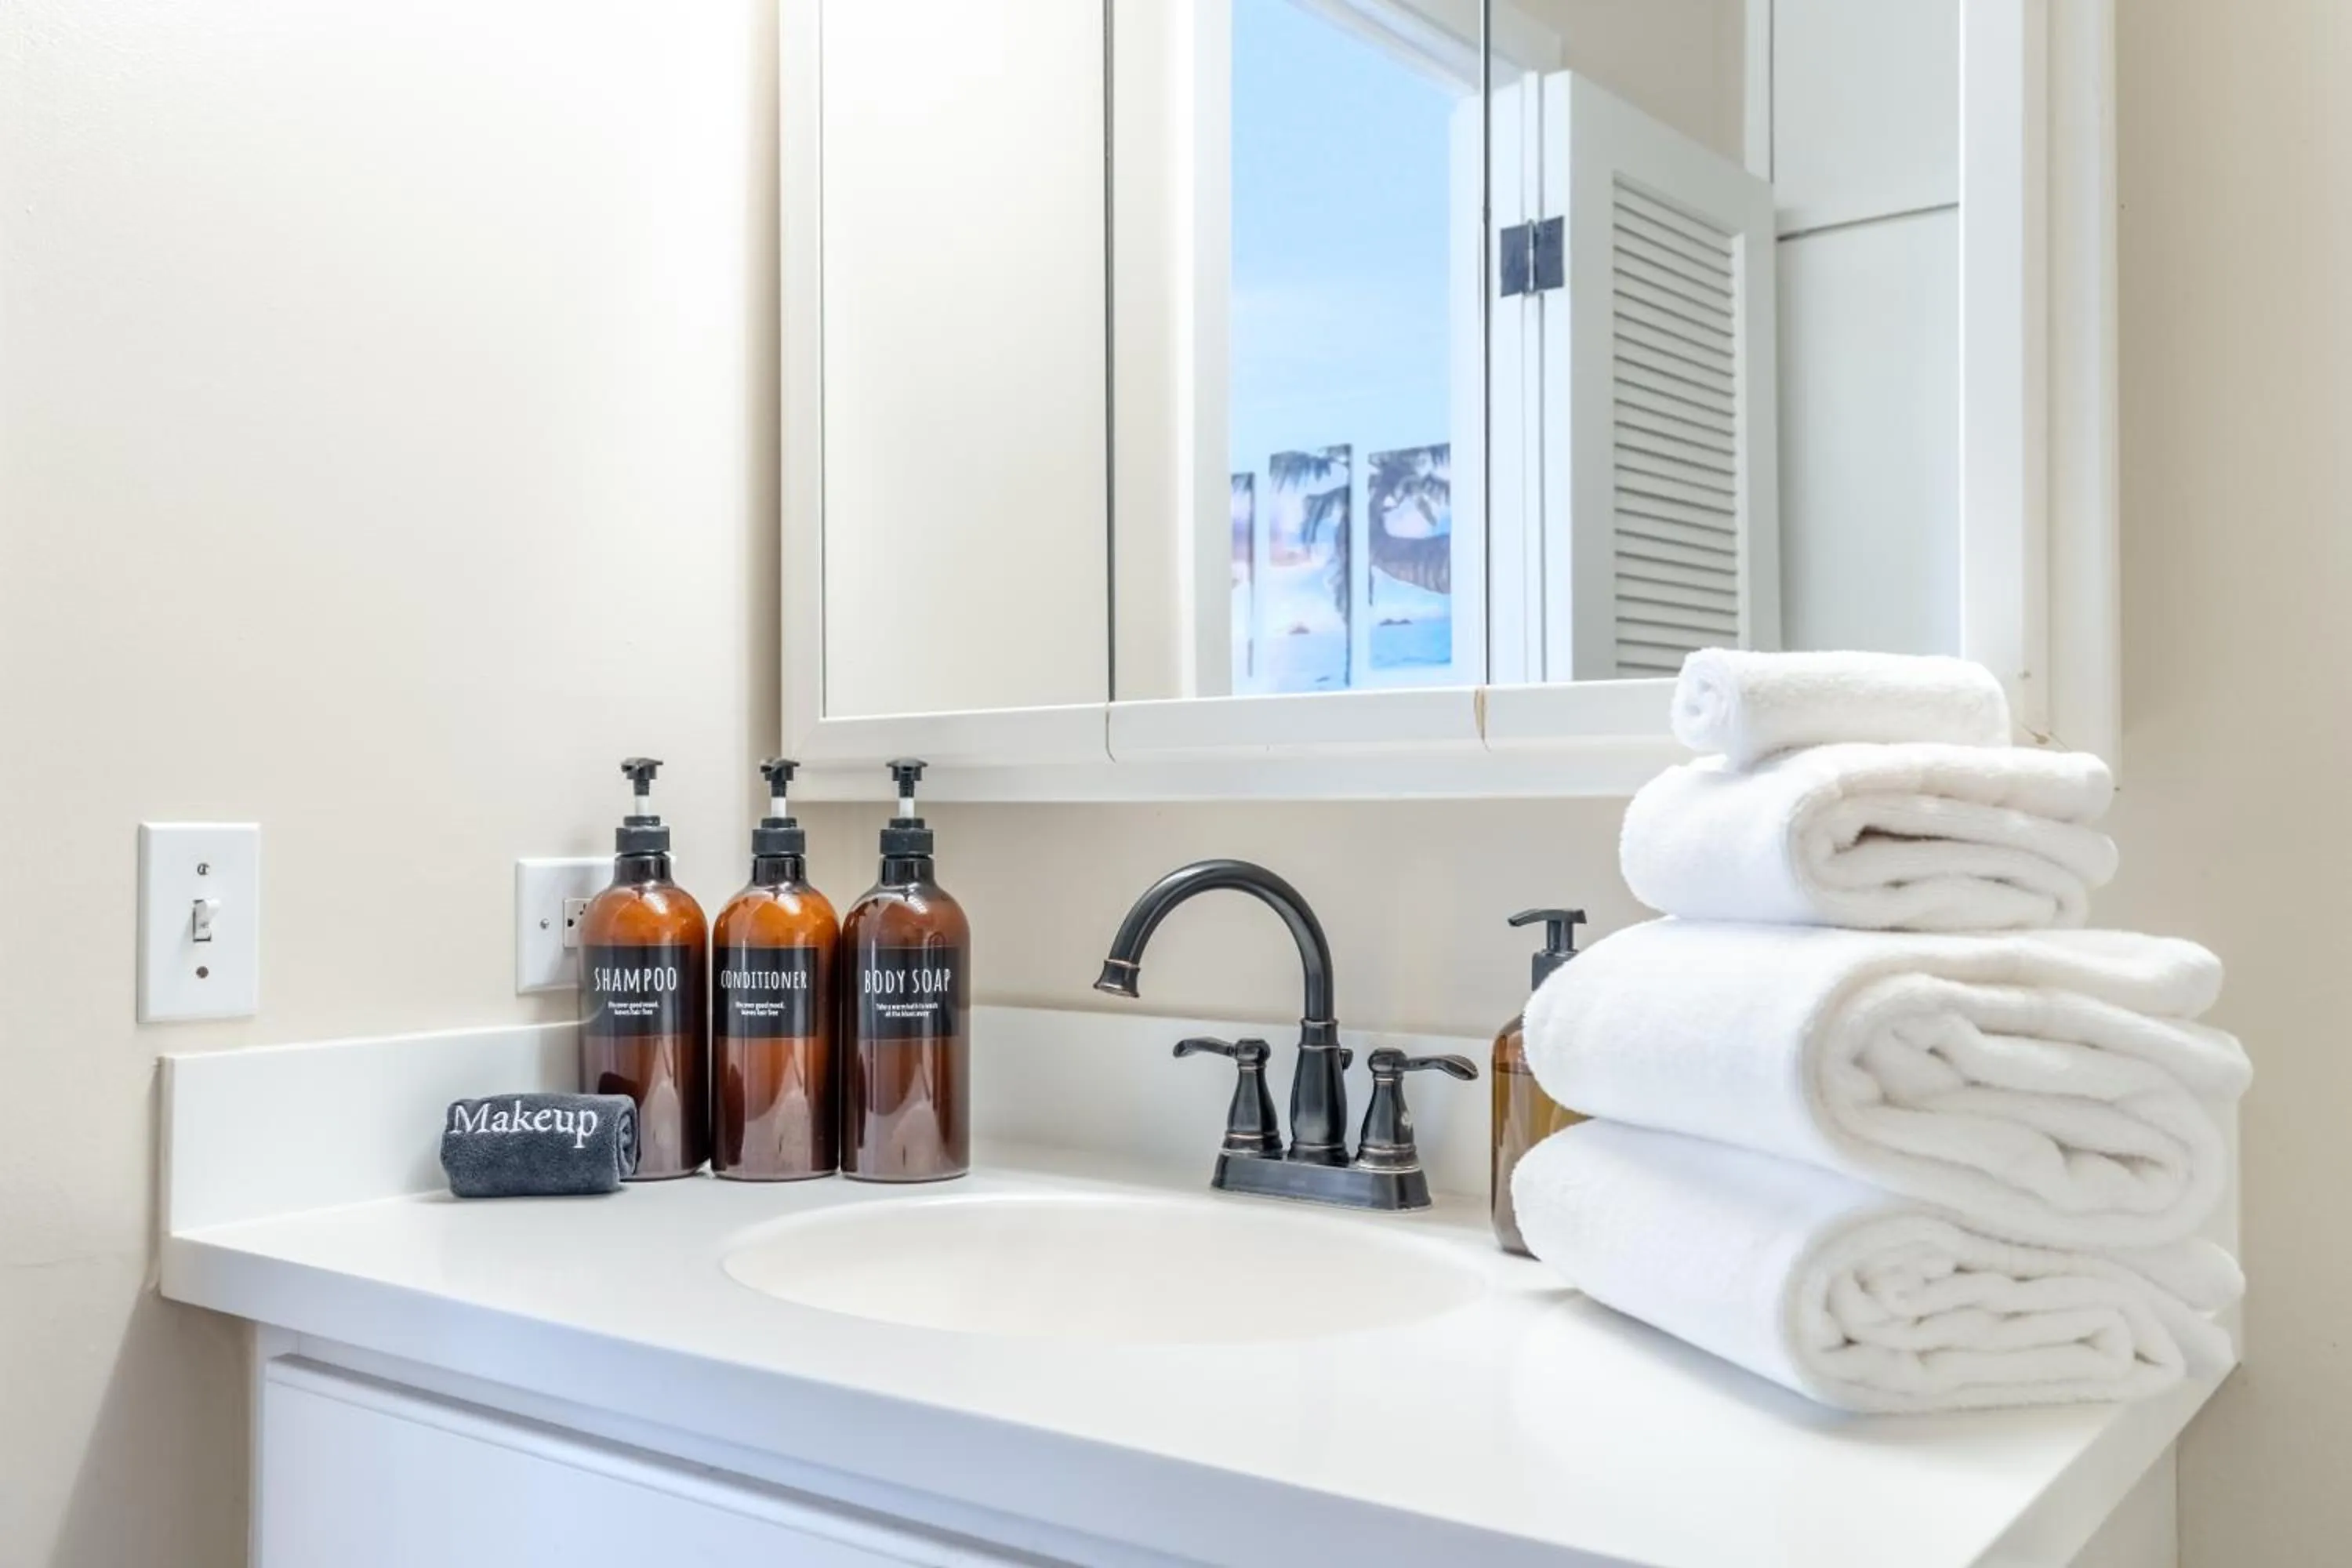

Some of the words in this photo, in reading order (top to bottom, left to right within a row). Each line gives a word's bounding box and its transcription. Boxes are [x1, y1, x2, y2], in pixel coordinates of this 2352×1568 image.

[594, 967, 677, 993] SHAMPOO
[721, 970, 807, 989] CONDITIONER
[865, 970, 906, 993] BODY
[912, 968, 951, 993] SOAP
[449, 1100, 597, 1149] Makeup
